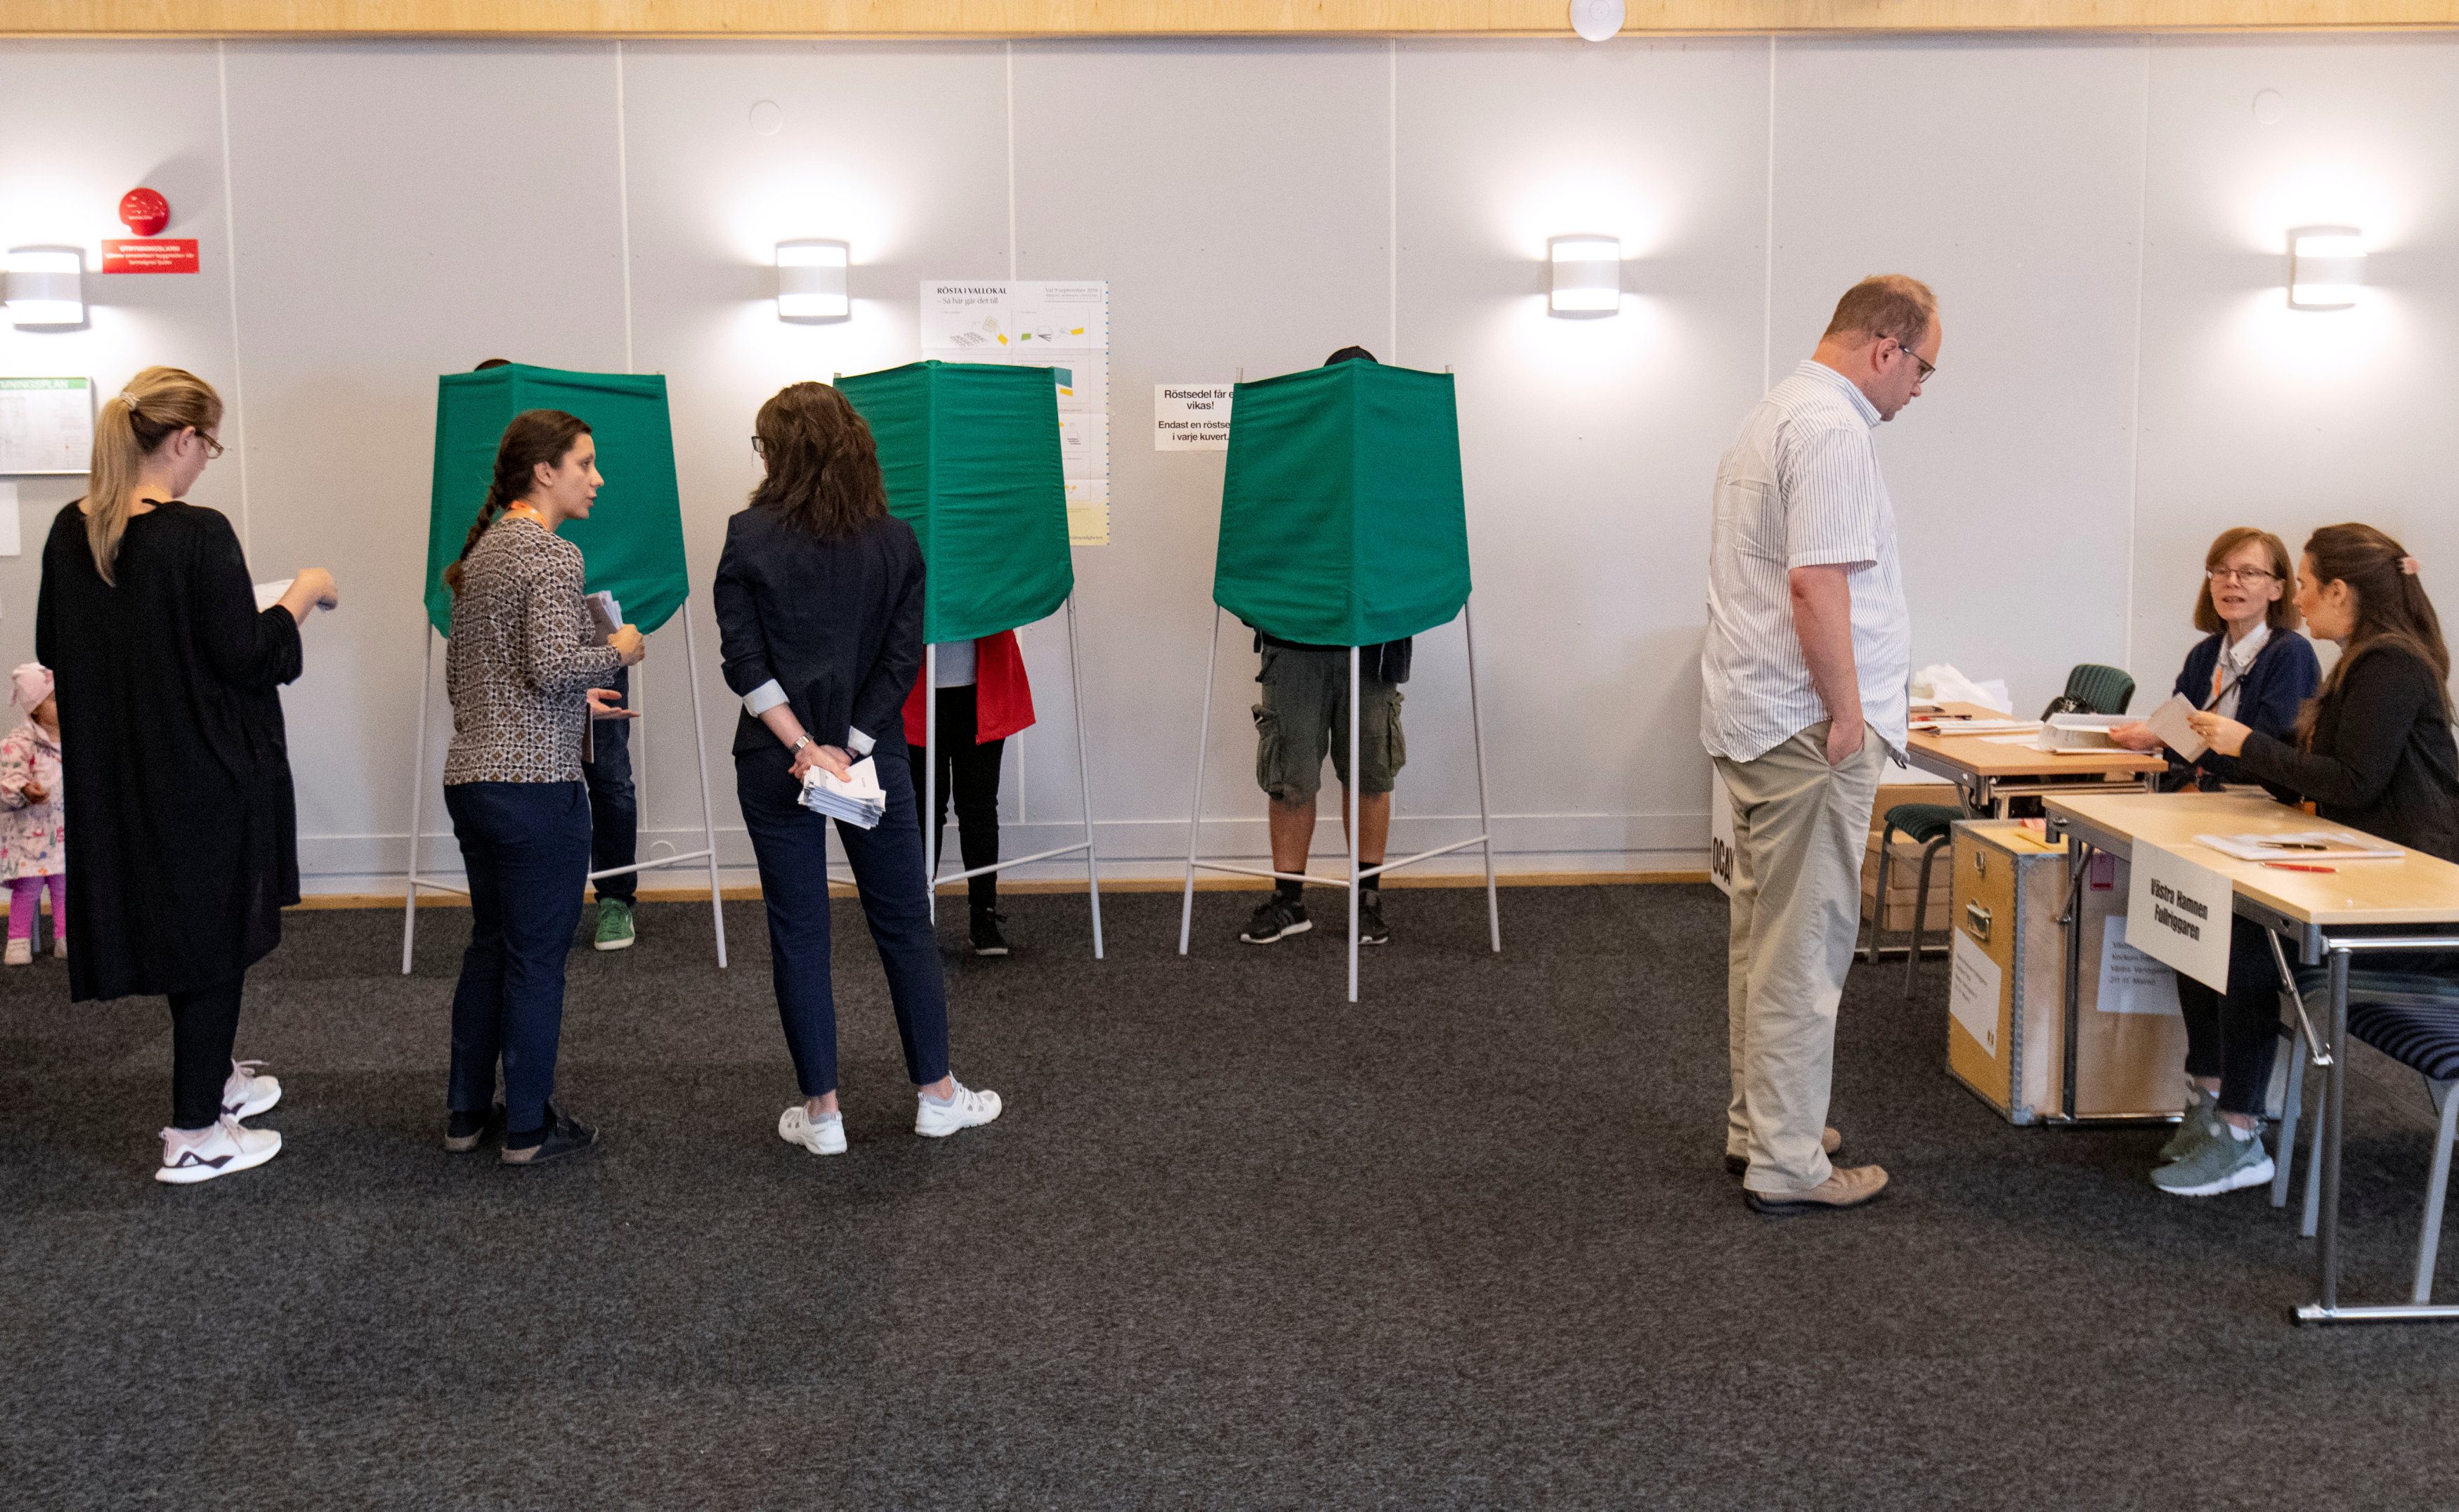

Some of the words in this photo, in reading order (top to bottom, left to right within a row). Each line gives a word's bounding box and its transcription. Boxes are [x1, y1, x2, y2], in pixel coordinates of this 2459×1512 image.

[937, 286, 963, 294] RÖSTA
[965, 297, 975, 306] går
[1164, 389, 1211, 398] Röstsedel
[1214, 389, 1226, 398] får
[1187, 401, 1214, 410] vikas!
[1177, 433, 1198, 443] varje
[2151, 878, 2174, 905] Västra
[2177, 890, 2208, 920] Hamnen
[2155, 904, 2200, 941] Fullriggaren
